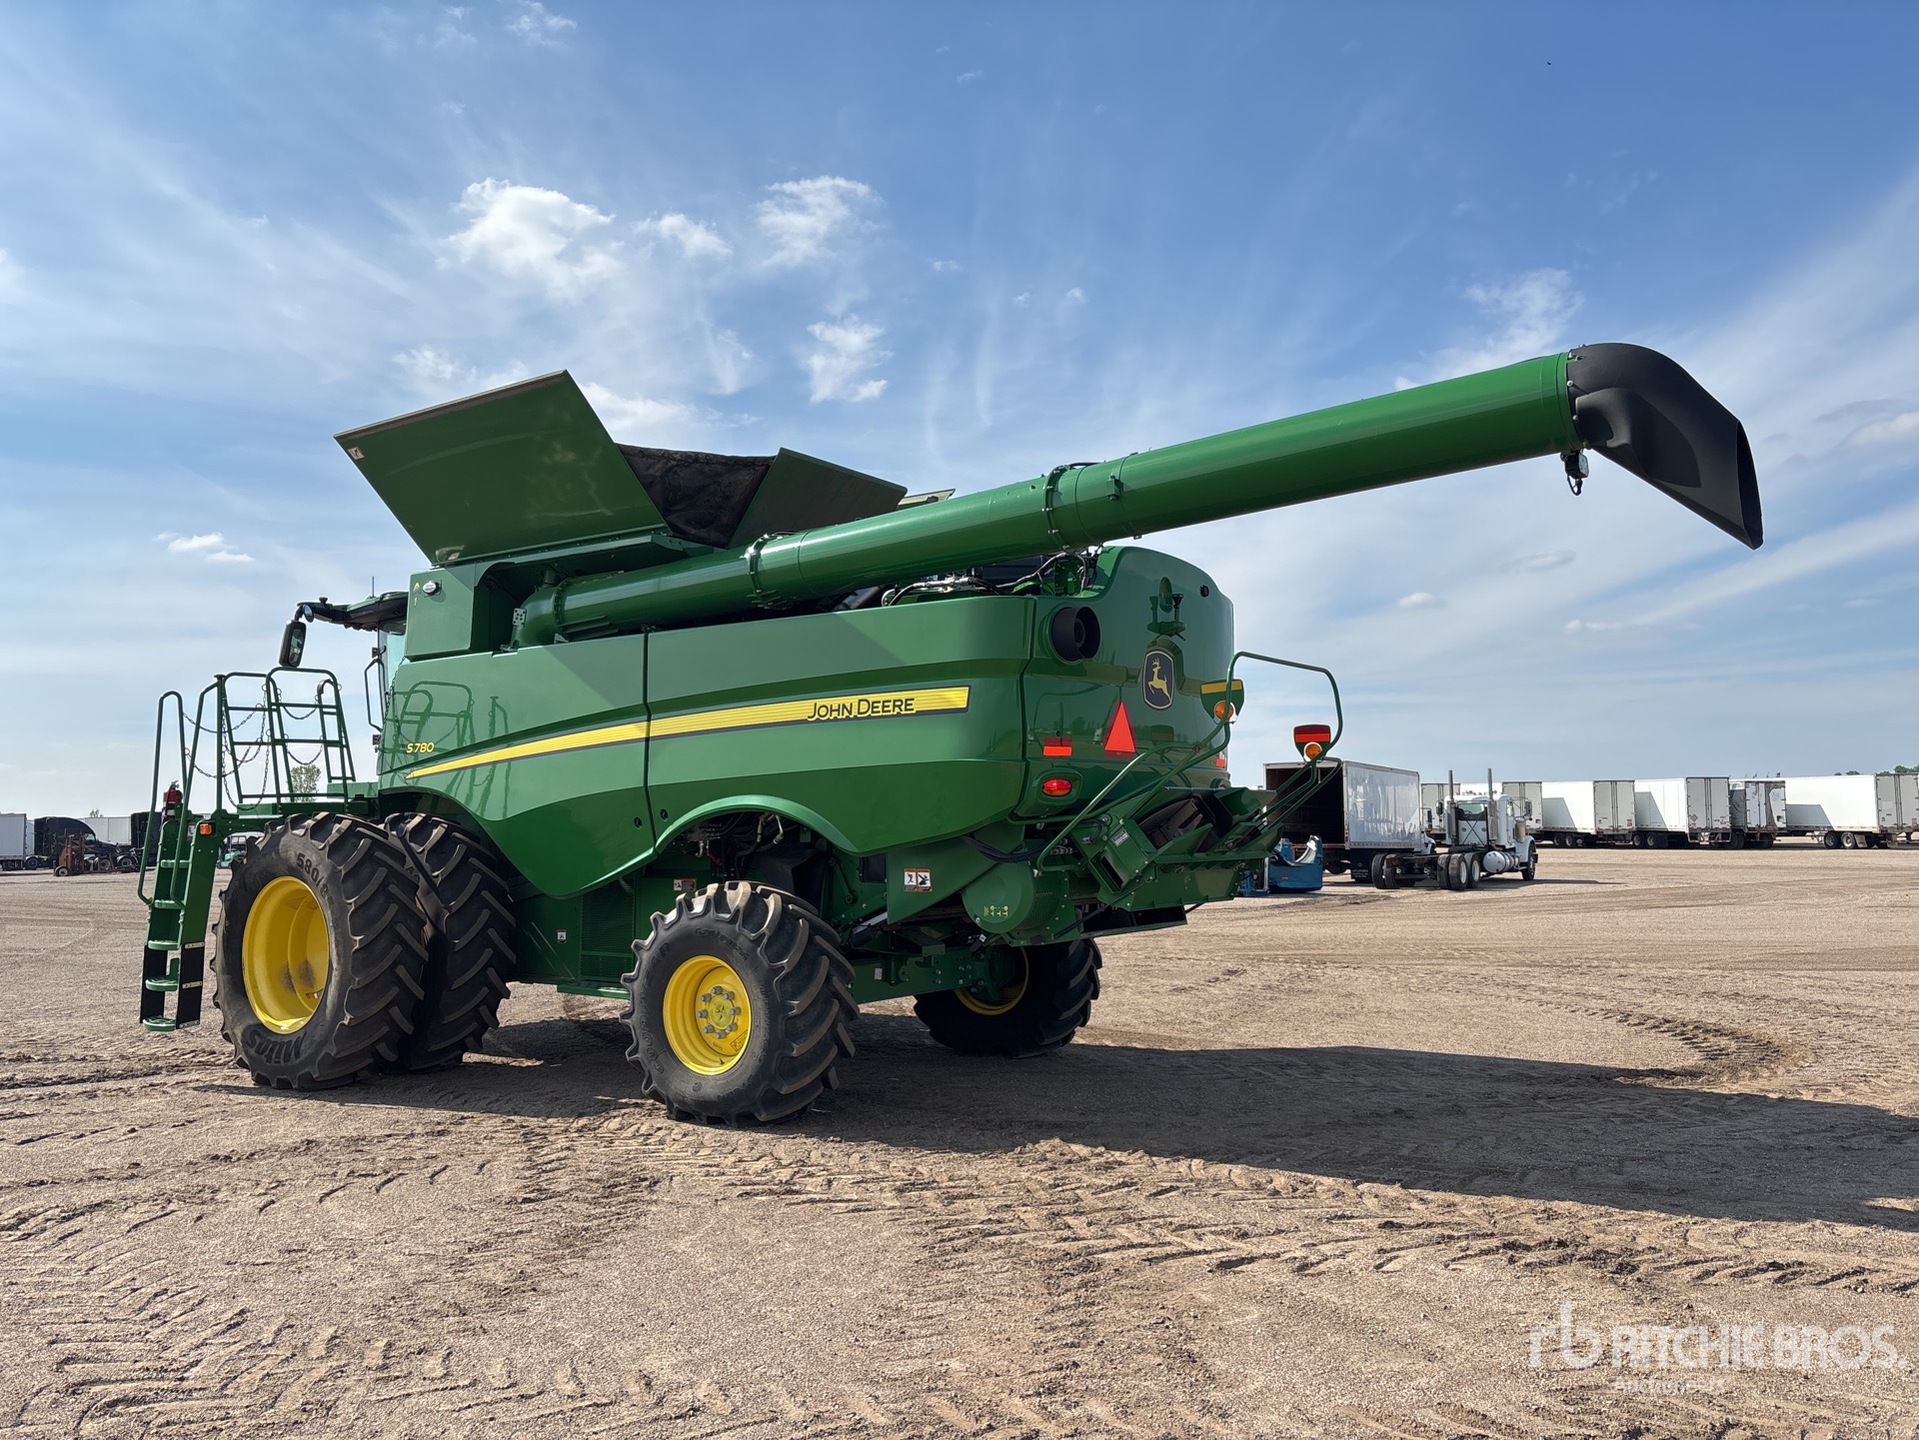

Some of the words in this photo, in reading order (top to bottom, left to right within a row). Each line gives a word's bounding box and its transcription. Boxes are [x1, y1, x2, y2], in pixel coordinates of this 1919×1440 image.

[807, 702, 853, 720] JOHN
[857, 698, 916, 716] DEERE
[406, 742, 435, 754] S780
